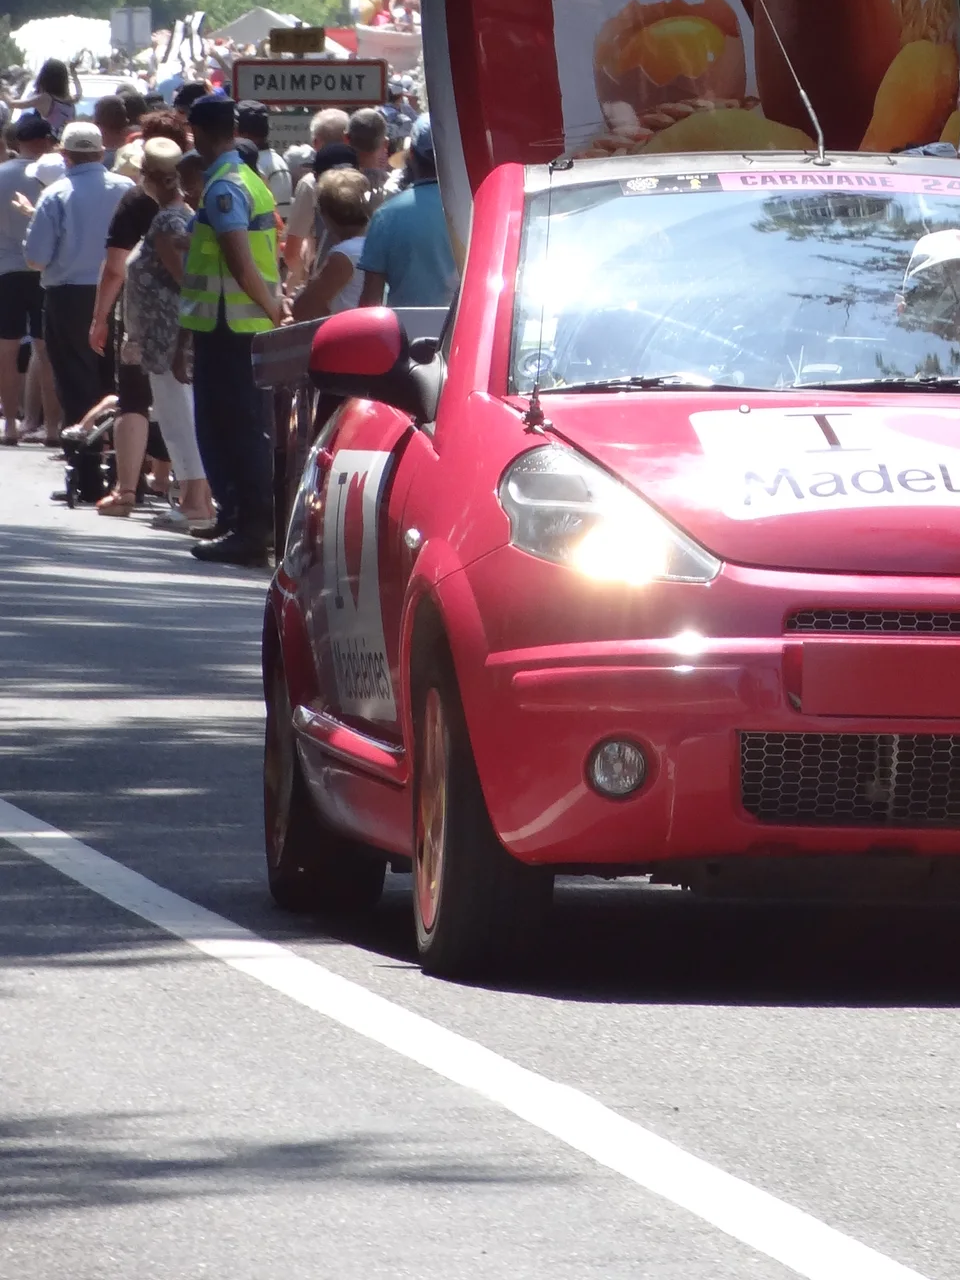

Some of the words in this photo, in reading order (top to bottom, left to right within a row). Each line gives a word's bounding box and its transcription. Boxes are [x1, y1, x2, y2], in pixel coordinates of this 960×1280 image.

[253, 72, 367, 92] PAIMPONT
[739, 172, 895, 189] CARAVANE
[784, 412, 873, 454] I
